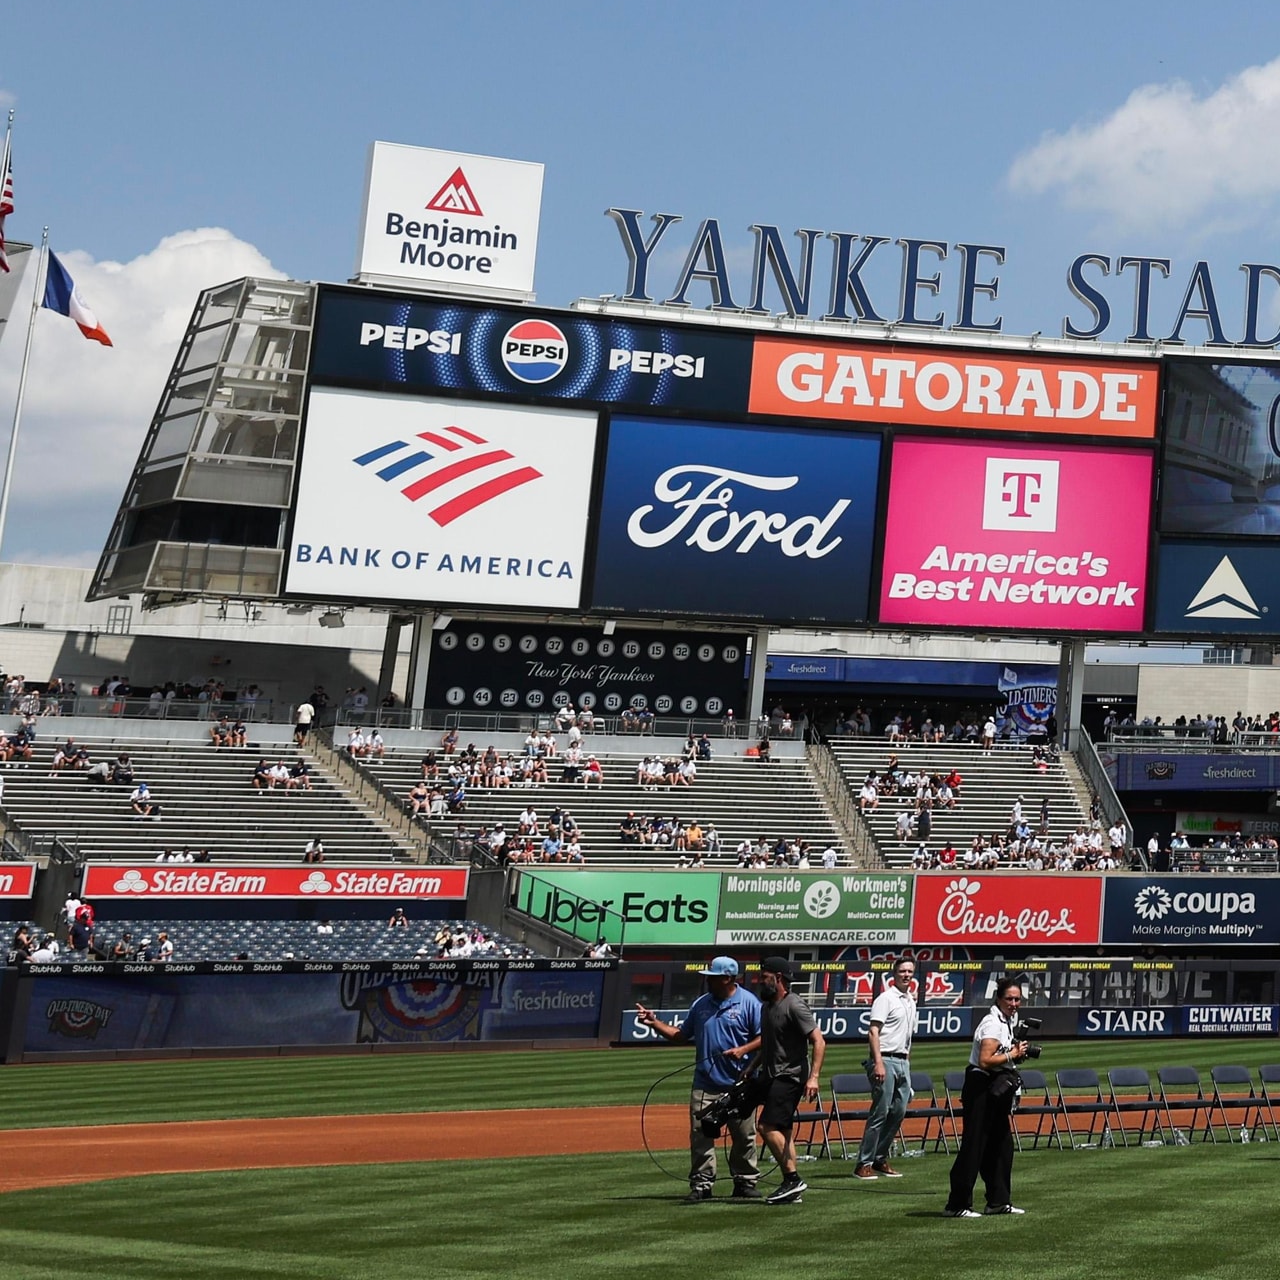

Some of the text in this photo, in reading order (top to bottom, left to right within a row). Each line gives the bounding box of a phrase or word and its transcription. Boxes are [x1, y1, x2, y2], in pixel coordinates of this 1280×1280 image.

[386, 212, 517, 250] Benjamin
[400, 243, 492, 274] Moore
[605, 207, 1006, 333] YANKEE
[361, 322, 461, 355] PEPSI
[505, 342, 565, 361] PEPSI
[609, 349, 705, 379] PEPSI
[776, 352, 1138, 422] GATORADE
[626, 464, 851, 560] Ford
[297, 544, 573, 580] BANK OF AMERICA
[921, 545, 1109, 577] America's
[889, 573, 1138, 607] Best Network
[445, 636, 736, 658] 4 3 5 7 37 8 8 16 15 32 9 10
[526, 661, 655, 688] New York Yankees
[788, 664, 826, 675] freshdirect
[454, 692, 718, 710] 1 44 23 49 42 6 51 46 20 2 21
[1205, 766, 1256, 779] freshdirect
[727, 875, 801, 896] Morningside
[843, 877, 907, 893] Workmen's
[528, 892, 708, 923] Uber Eats
[758, 903, 784, 912] Nursing
[870, 893, 905, 909] Circle
[1173, 892, 1256, 920] coupa
[725, 911, 799, 920] Rehabilitation Center
[847, 911, 905, 920] MultiCare Center
[937, 890, 1077, 939] Chick-fil-A
[730, 930, 896, 943] WWW.CASSENACARE.COM
[1132, 925, 1160, 935] Make
[1163, 925, 1207, 937] Margins
[30, 965, 62, 973] StubHub
[513, 990, 594, 1011] freshdirect
[1086, 1010, 1165, 1031] STARR
[1189, 1007, 1272, 1023] CUTWATER
[1188, 1024, 1200, 1032] REAL
[1229, 1024, 1255, 1032] PERFECTLY
